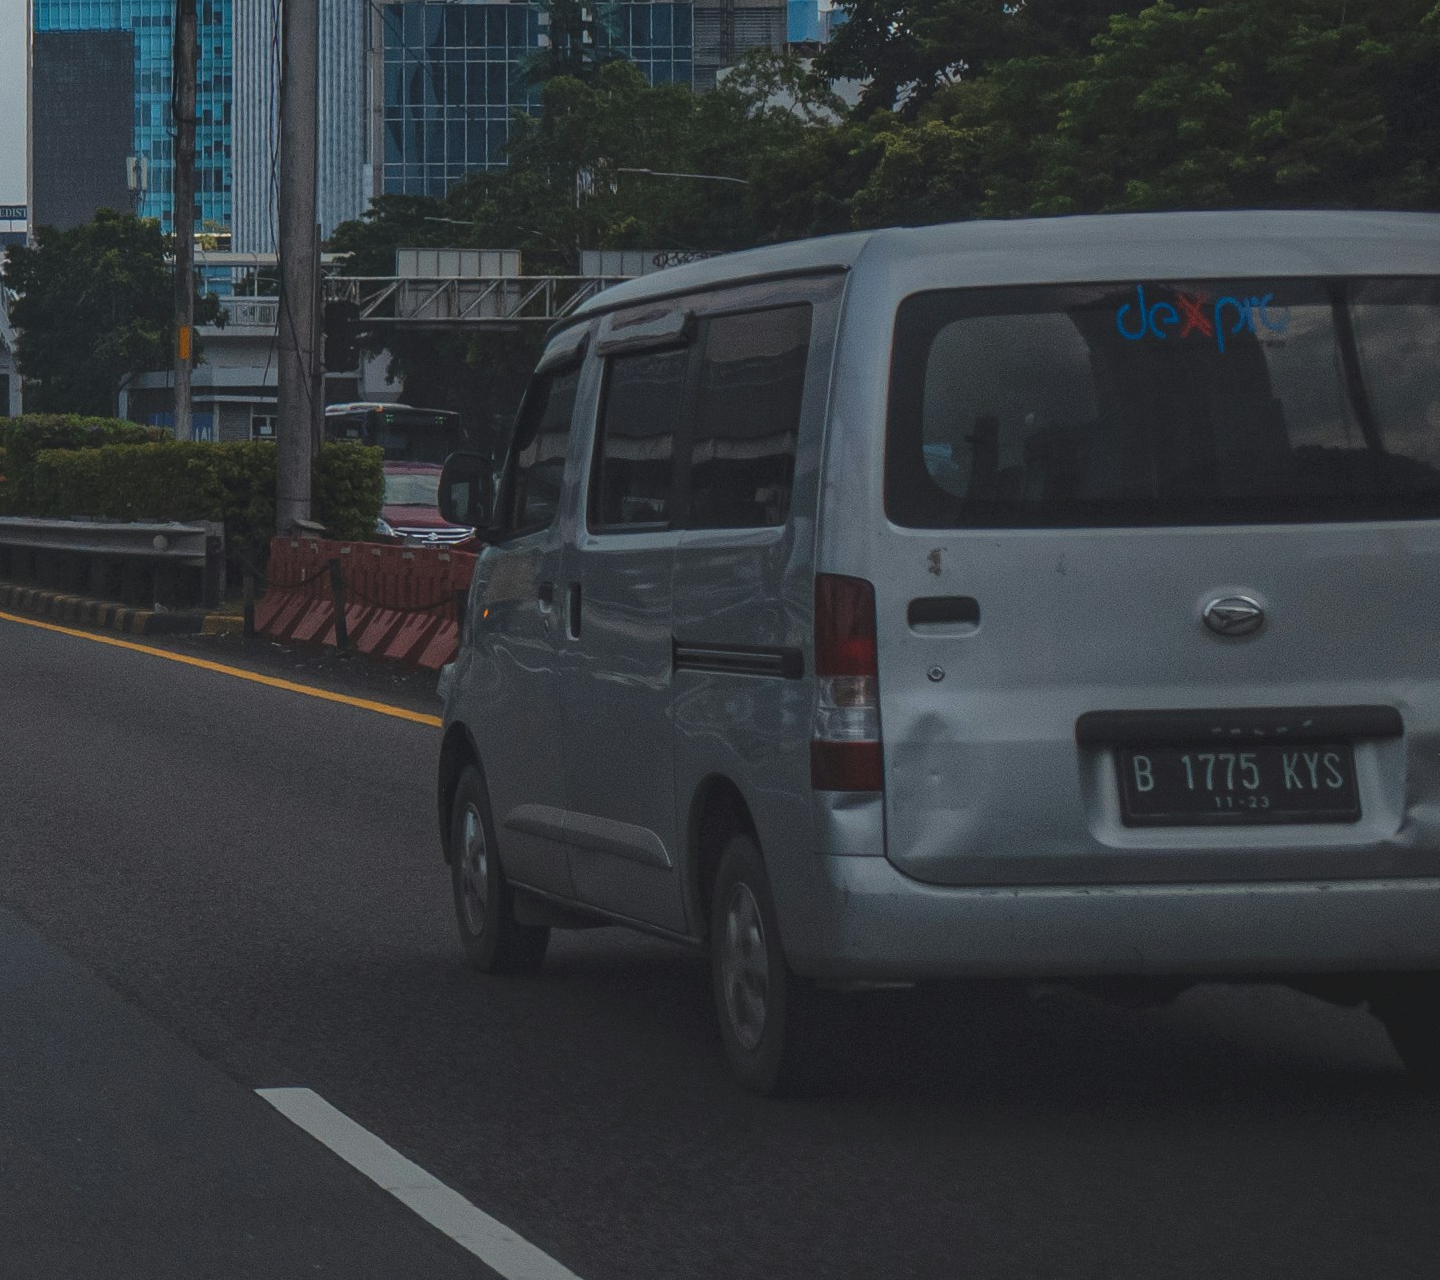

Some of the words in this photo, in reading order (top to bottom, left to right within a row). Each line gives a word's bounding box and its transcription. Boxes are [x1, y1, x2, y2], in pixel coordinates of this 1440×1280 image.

[1132, 754, 1155, 793] B
[1181, 752, 1260, 791] 1775
[1281, 752, 1344, 790] KYS
